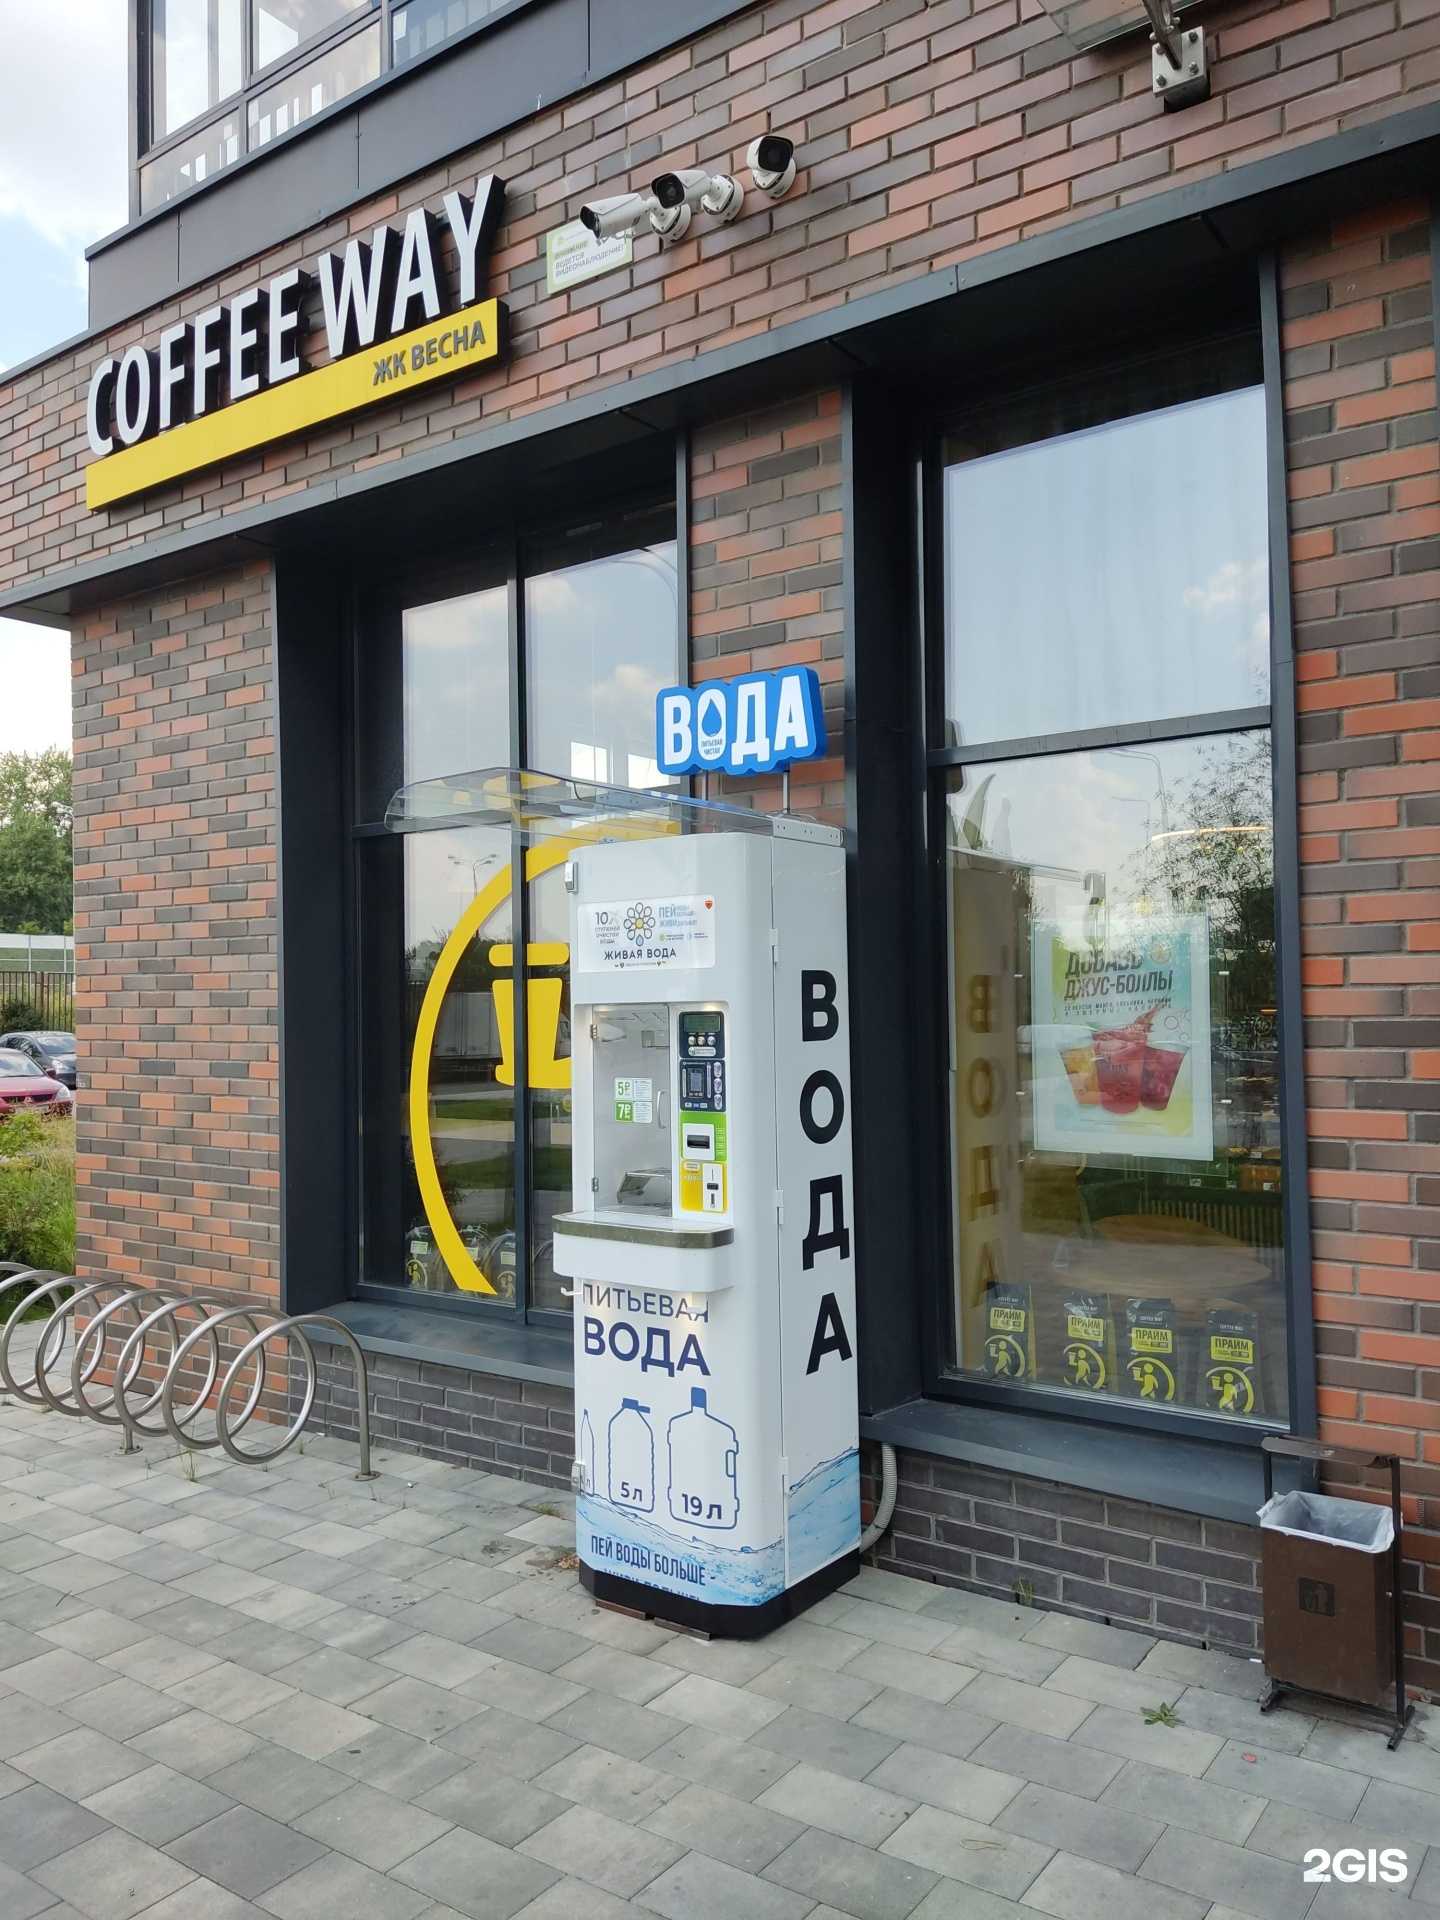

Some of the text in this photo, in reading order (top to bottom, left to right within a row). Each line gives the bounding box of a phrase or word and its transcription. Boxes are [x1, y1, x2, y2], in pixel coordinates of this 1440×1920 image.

[87, 174, 497, 456] COFFEE WAY
[372, 320, 487, 387] ЖК ВЕСНА
[663, 675, 809, 766] ВОДА
[595, 911, 609, 926] 10
[604, 947, 677, 961] ЖИВАЯ ВОДА
[1064, 970, 1173, 1001] ДЖУС-БОЛЛЫ
[800, 969, 853, 1375] ВОДА
[584, 1315, 711, 1377] ВОДА
[620, 1481, 644, 1503] 5 л
[681, 1493, 722, 1521] 19 л
[591, 1534, 613, 1561] ПЕЙ
[616, 1540, 650, 1572] ВОДЫ
[654, 1552, 706, 1587] БОЛЬШЕ
